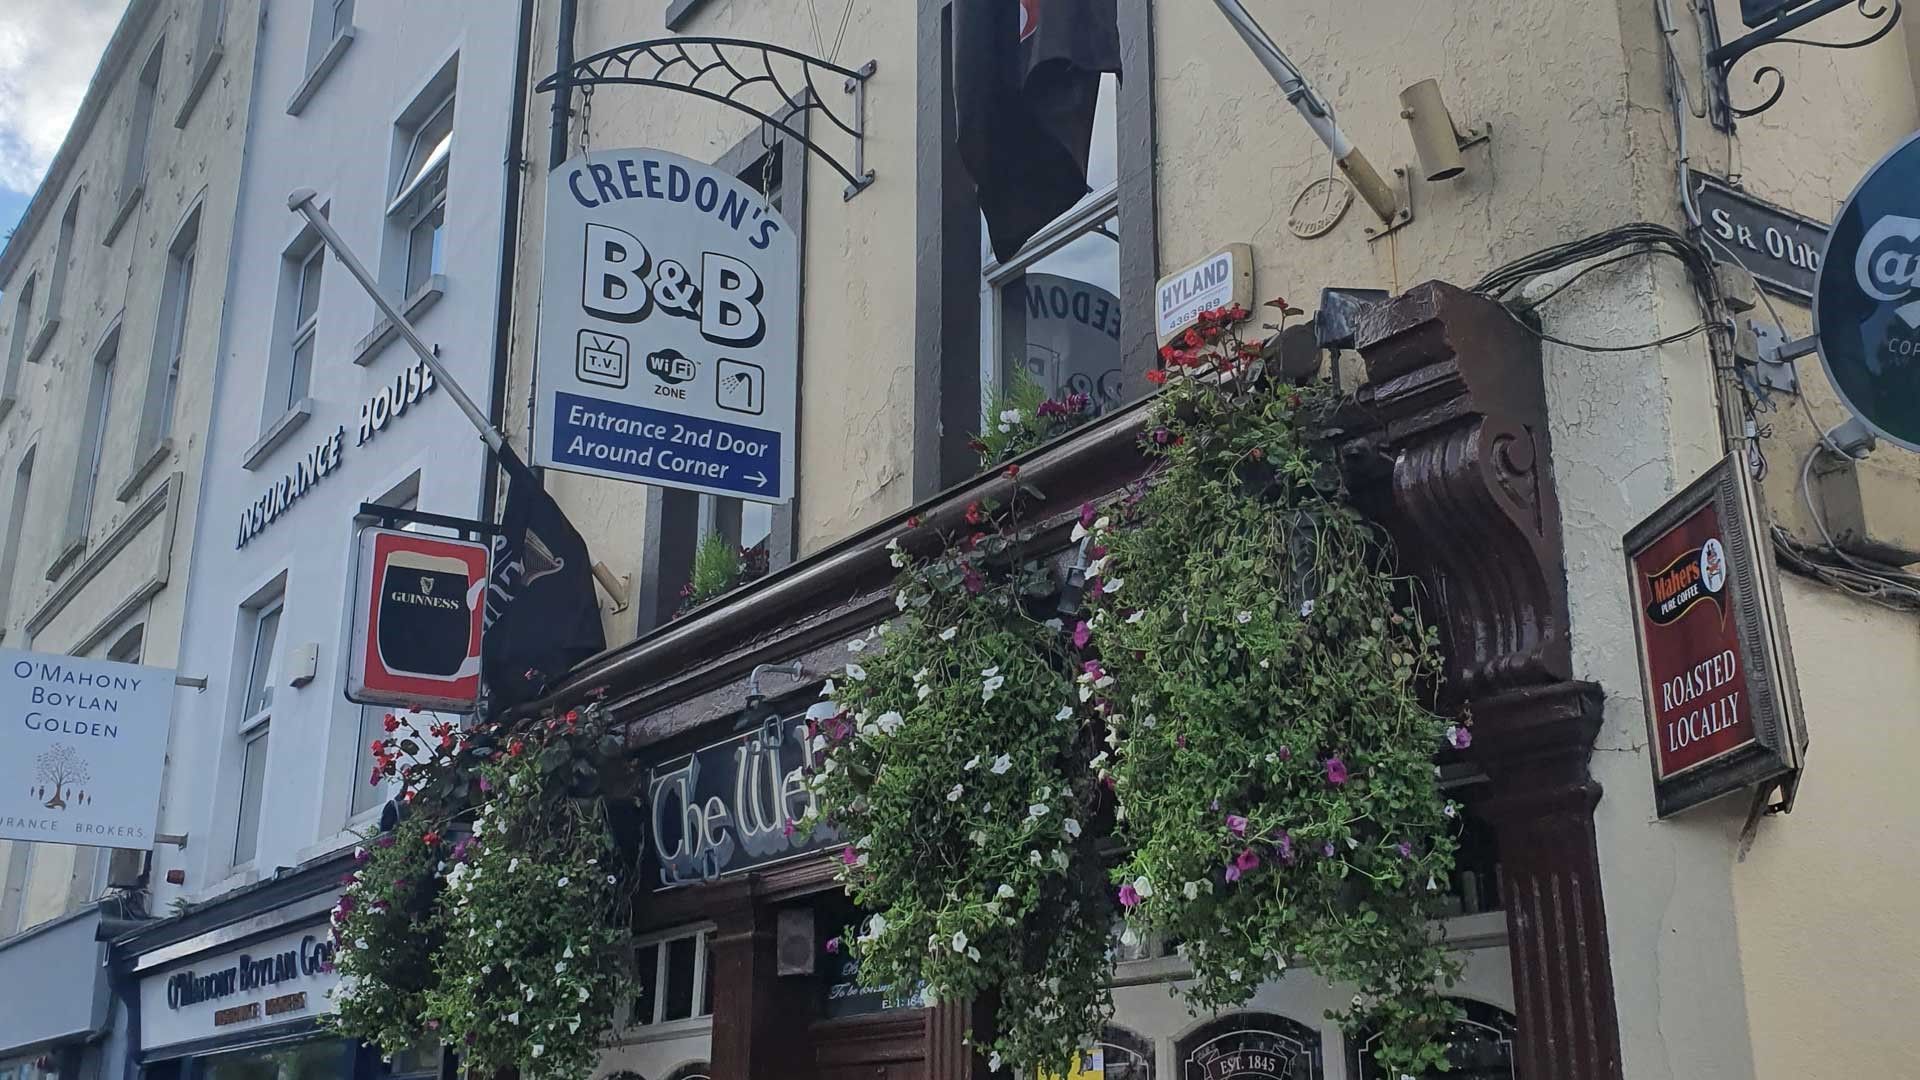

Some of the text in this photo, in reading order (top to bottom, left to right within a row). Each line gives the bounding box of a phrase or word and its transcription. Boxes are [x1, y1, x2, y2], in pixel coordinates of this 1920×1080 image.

[568, 159, 780, 250] CREEDON'S
[582, 222, 766, 349] B&B
[1161, 258, 1229, 313] HYLAND
[589, 355, 618, 371] T.V.
[653, 384, 687, 400] ZONE
[233, 343, 439, 551] INSURANCE HOUSE
[568, 404, 769, 458] Entrance 2nd Door
[567, 435, 730, 480] Around Corner
[391, 591, 460, 611] GUINNESS
[1653, 559, 1700, 604] Mahers
[1660, 583, 1700, 616] PURE COFFEE
[14, 660, 142, 692] O'MAHONY
[1662, 649, 1737, 713] ROASTED
[31, 686, 118, 712] BOYLAN
[24, 712, 118, 738] GOLDEN
[1668, 692, 1740, 753] LOCALLY
[649, 752, 728, 861] The
[75, 822, 145, 838] BROKERS
[1219, 1055, 1276, 1075] EST. 1845
